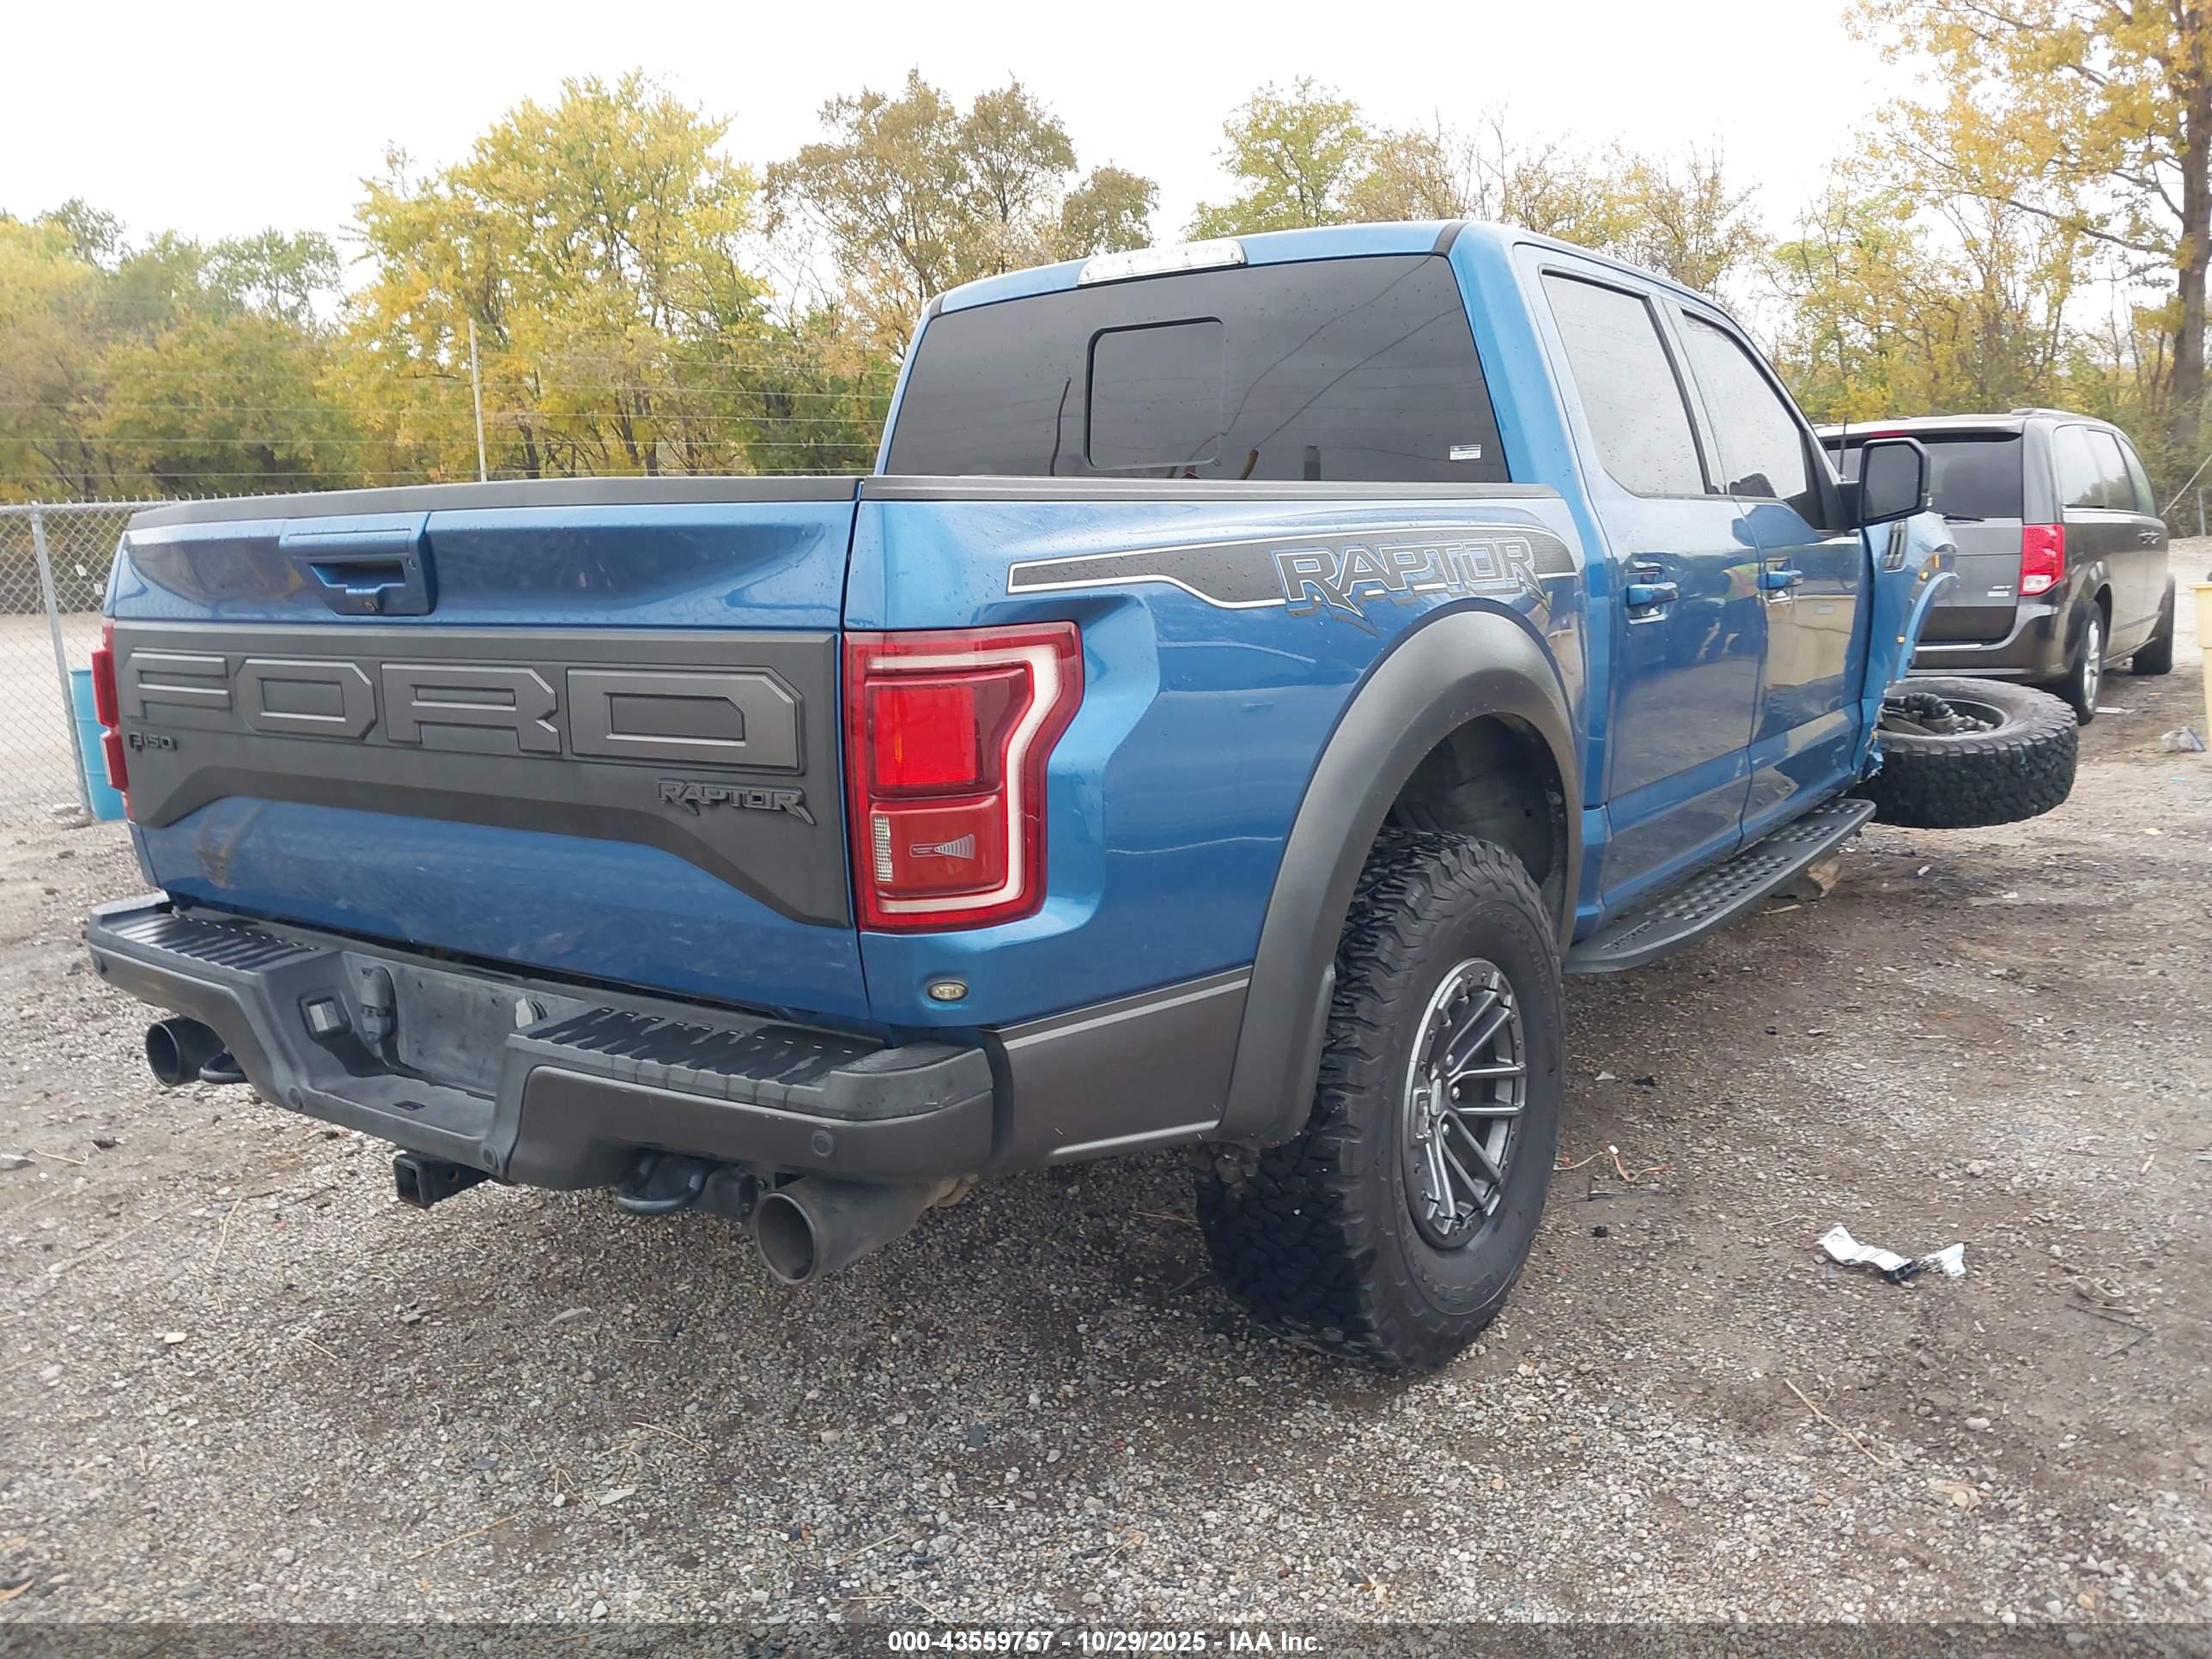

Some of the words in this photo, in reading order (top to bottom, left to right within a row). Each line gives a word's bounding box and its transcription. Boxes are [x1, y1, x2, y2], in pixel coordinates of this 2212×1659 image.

[1273, 537, 1552, 622] RAPTOR
[124, 649, 805, 774] FORD
[658, 779, 816, 825] RAPTOR
